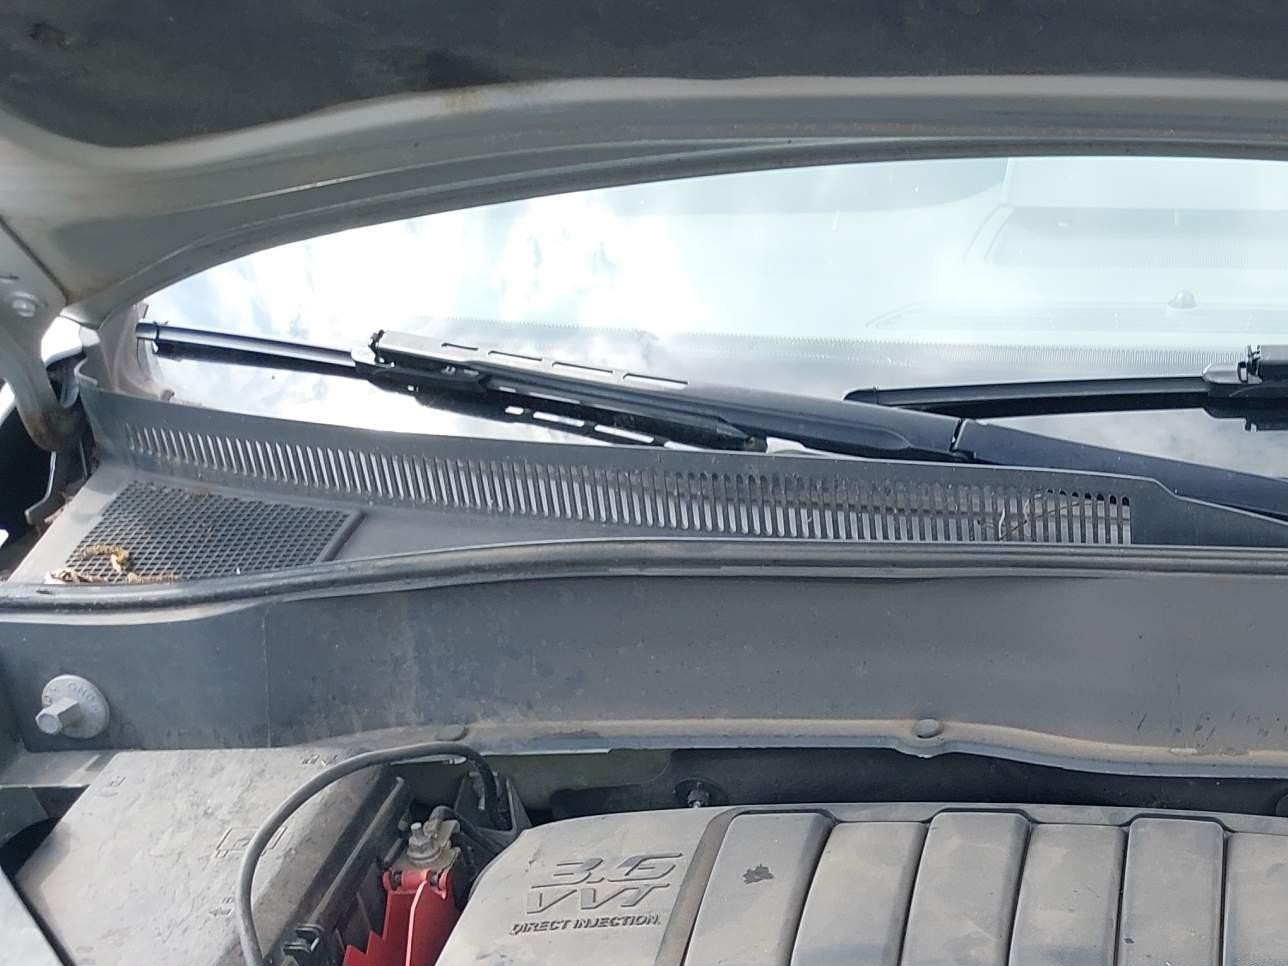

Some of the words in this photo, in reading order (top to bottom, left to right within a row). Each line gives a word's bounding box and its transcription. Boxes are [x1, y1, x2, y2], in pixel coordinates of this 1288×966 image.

[531, 852, 683, 889] 3.6
[526, 883, 670, 914] VVT
[509, 919, 571, 936] DIRECT
